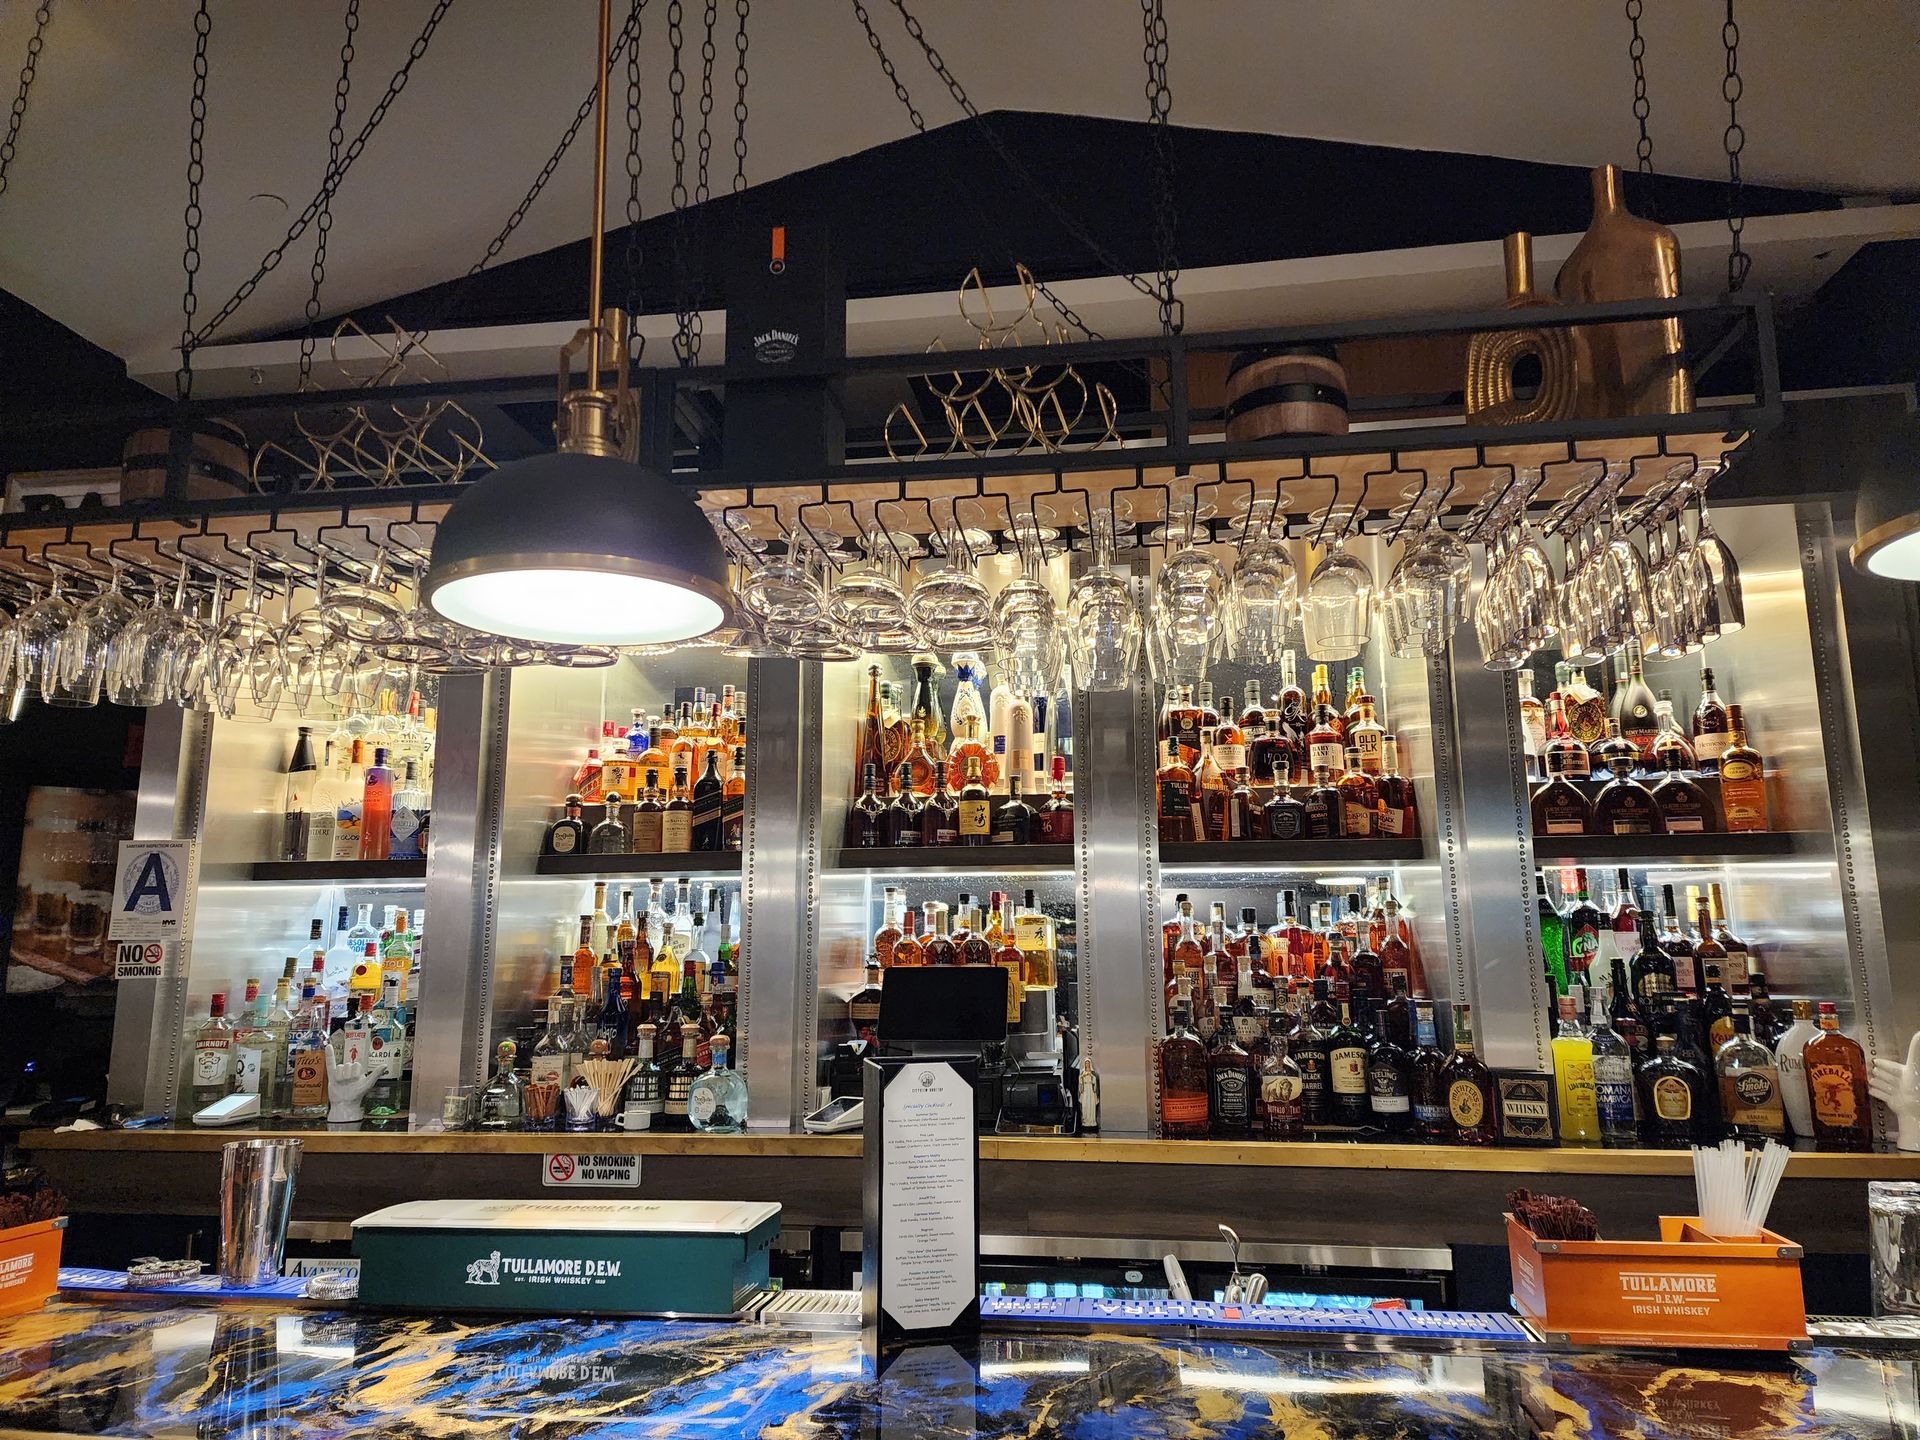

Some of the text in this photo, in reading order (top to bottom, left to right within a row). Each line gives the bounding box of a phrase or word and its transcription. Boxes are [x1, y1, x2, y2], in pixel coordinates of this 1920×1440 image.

[753, 329, 799, 347] JACK DANIEL'S
[1359, 735, 1377, 743] OLD
[1699, 739, 1727, 748] Hennessy
[1360, 743, 1377, 752] ELK
[285, 807, 303, 820] elit
[123, 852, 172, 911] A
[119, 945, 143, 962] NO
[117, 966, 161, 976] SMOKING
[345, 1031, 366, 1039] BEEFEATER
[196, 1040, 228, 1048] SMIRNOFF
[296, 1055, 321, 1065] Tito's
[1294, 1051, 1325, 1061] JAMESON
[1334, 1050, 1368, 1061] JAMESO
[1216, 1073, 1228, 1082] JACK
[1370, 1071, 1397, 1081] TEELING
[1812, 1067, 1851, 1082] FIREBALL
[1415, 1105, 1449, 1114] TEMPLETO
[1505, 1103, 1546, 1114] WHISKY
[577, 1155, 635, 1167] NO SMOKING
[581, 1169, 631, 1180] NO VAPING
[501, 1257, 622, 1277] TULLAMORE D.E.W.
[528, 1276, 551, 1284] IRISH
[553, 1276, 591, 1285] WHISKEY
[1619, 1276, 1717, 1293] TULLAMORE
[1654, 1295, 1685, 1304] D.E.W.
[1098, 1303, 1216, 1319] ULTRA
[1632, 1305, 1711, 1316] IRISH WHISKEY
